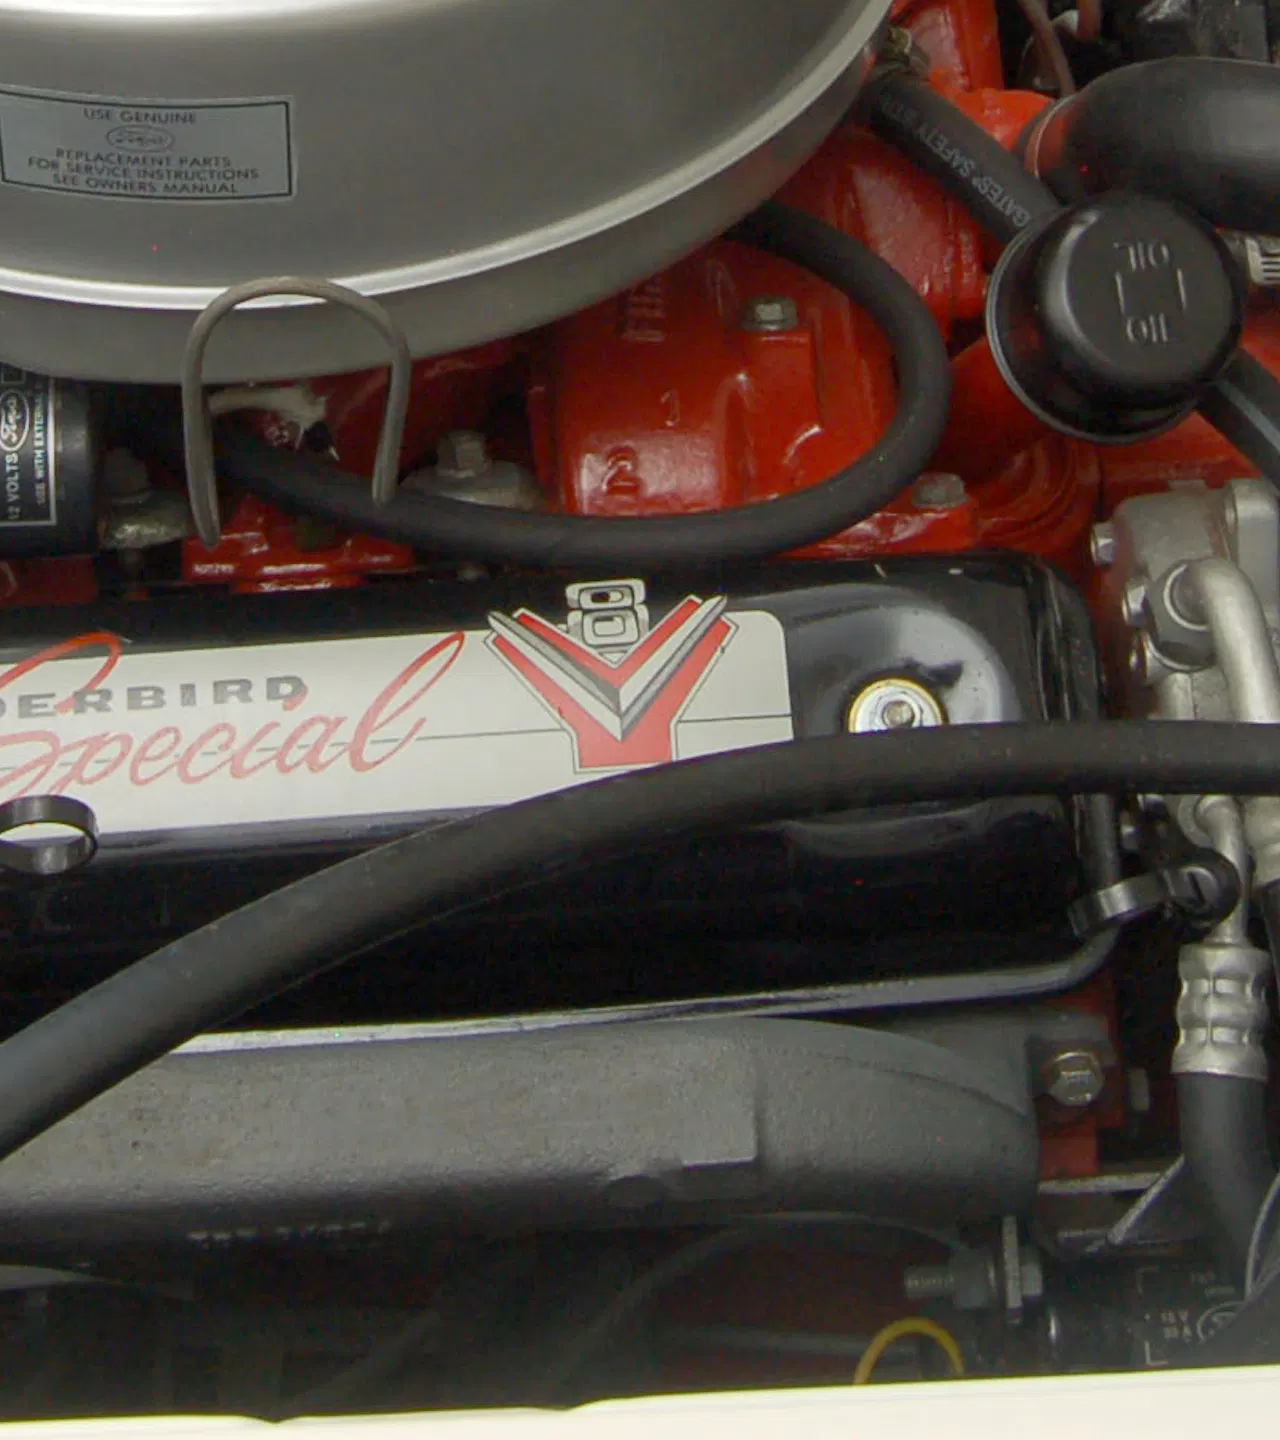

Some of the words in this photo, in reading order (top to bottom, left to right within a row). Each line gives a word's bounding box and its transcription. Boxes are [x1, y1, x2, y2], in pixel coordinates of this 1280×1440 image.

[83, 107, 113, 121] USE
[120, 110, 197, 125] GENUINE
[28, 155, 60, 171] FOR
[66, 161, 130, 179] SERVICE
[136, 166, 260, 182] INSTRUCTIONS
[55, 147, 172, 167] REPLACEMENT
[179, 155, 232, 169] PARTS
[52, 172, 79, 187] SEE
[84, 176, 158, 193] OWNERS
[163, 181, 238, 195] MANUAL
[5, 451, 20, 502] VOLTS
